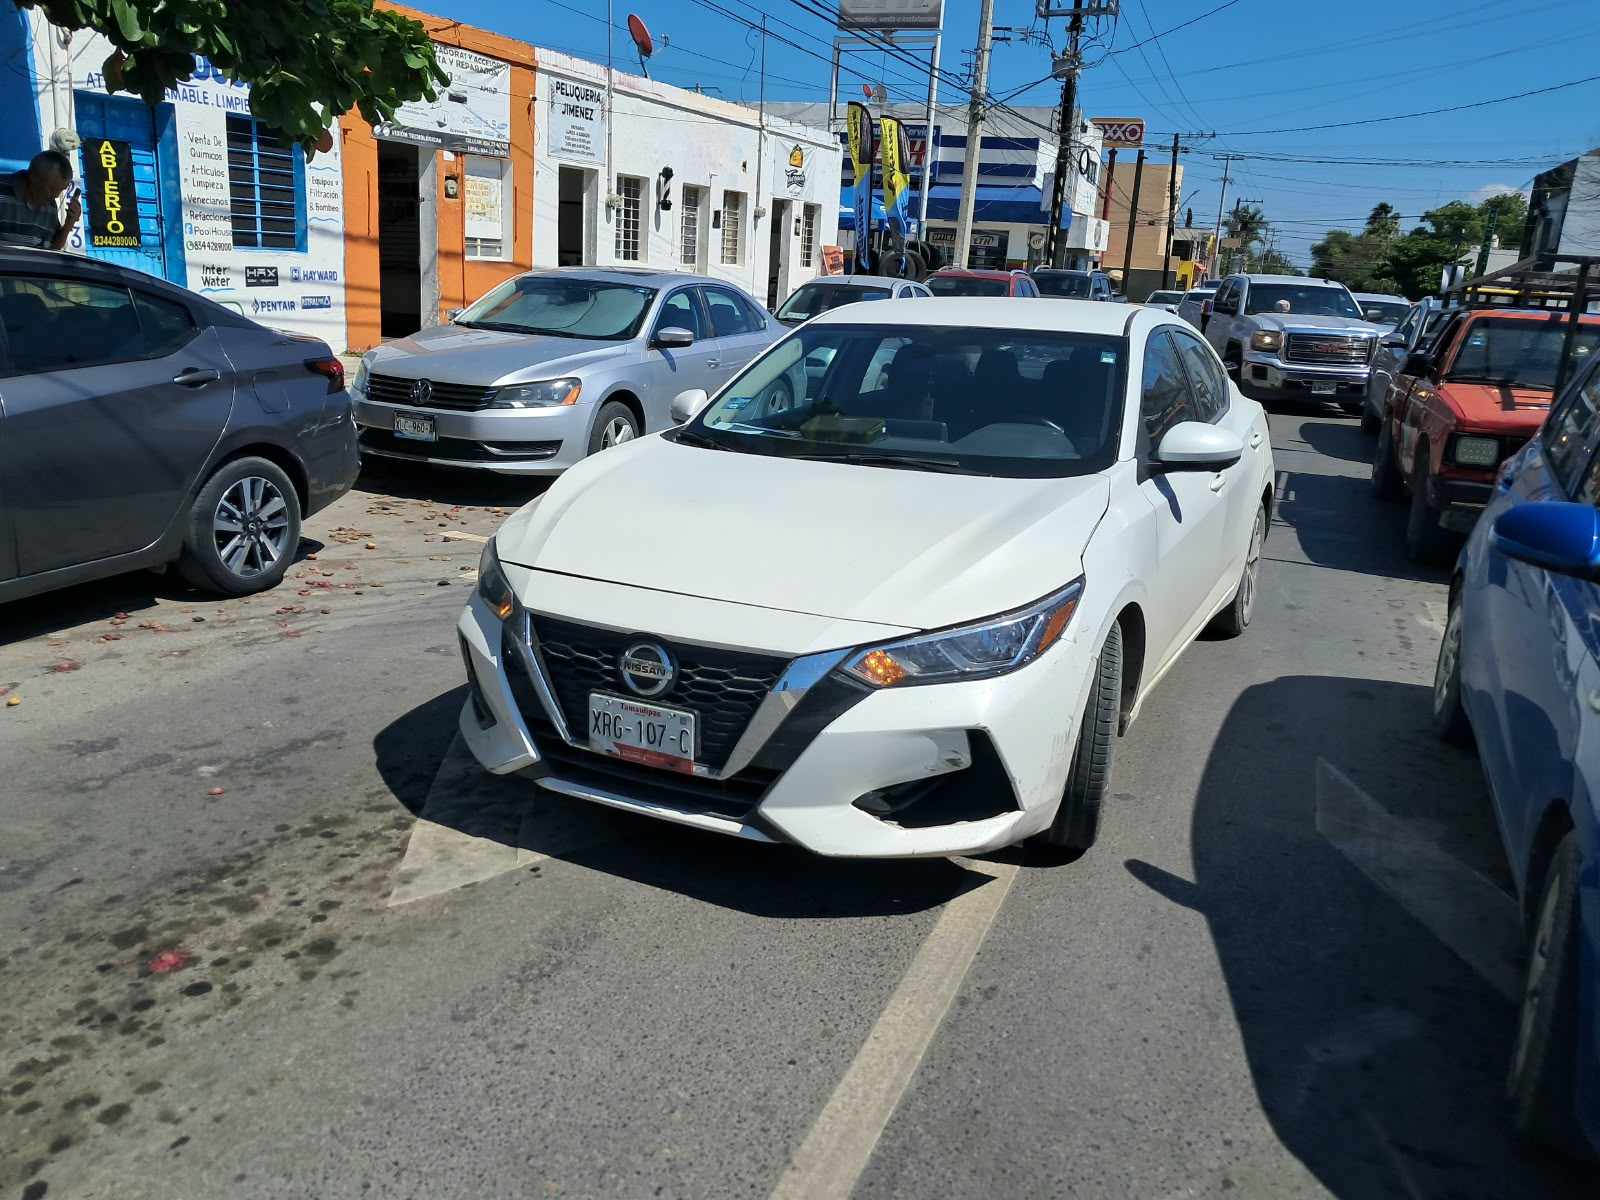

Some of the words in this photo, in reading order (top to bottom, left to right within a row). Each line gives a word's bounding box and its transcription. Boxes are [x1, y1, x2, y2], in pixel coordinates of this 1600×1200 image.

[561, 102, 594, 121] JIMENEZ
[187, 131, 211, 146] Venta
[213, 135, 223, 147] De
[99, 140, 124, 234] ABIERTO
[189, 209, 232, 222] Refacciones
[94, 235, 138, 247] 8344289000
[202, 263, 228, 276] Inter
[302, 270, 338, 282] HAYWARD
[201, 275, 231, 288] Water
[260, 300, 296, 313] PENTAIR
[623, 662, 666, 677] NISSAN
[620, 702, 662, 718] Tamaulipas
[591, 708, 691, 755] XRG-107-C
